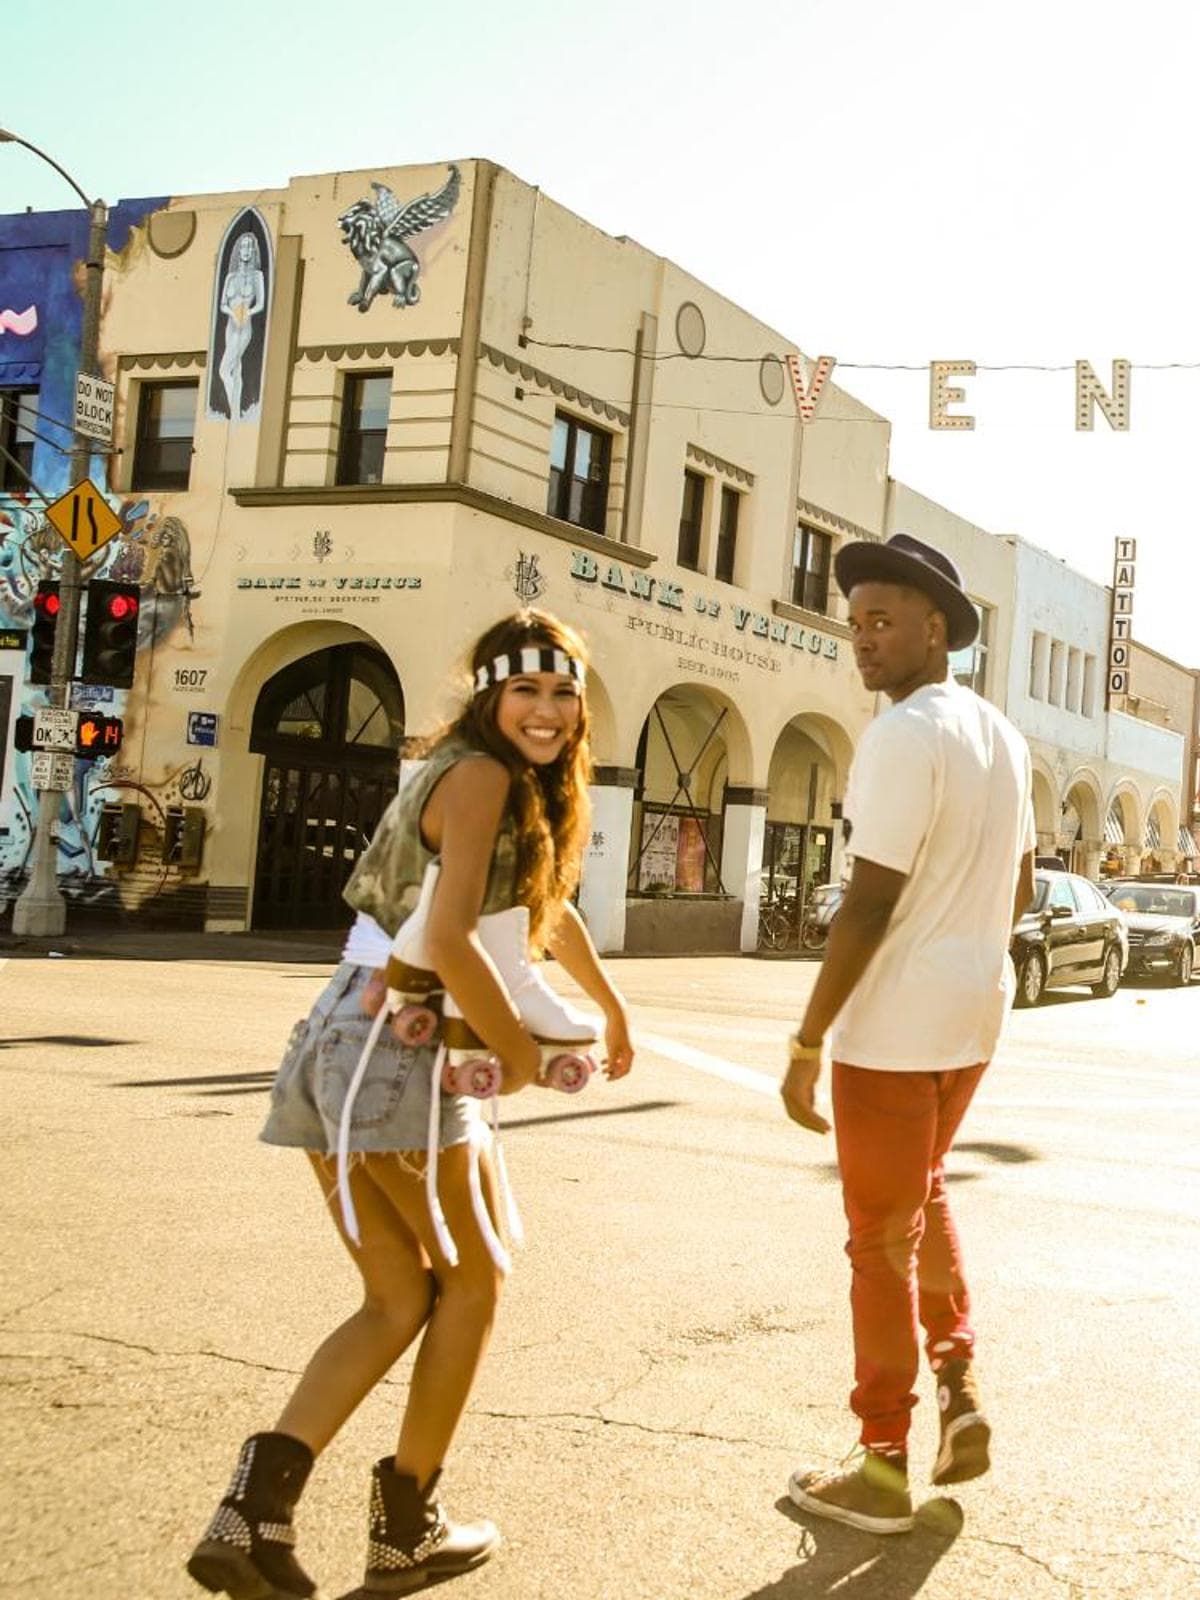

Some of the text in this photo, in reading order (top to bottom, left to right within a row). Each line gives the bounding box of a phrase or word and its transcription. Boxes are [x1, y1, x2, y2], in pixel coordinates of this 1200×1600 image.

[77, 380, 113, 404] DO NOT
[76, 400, 113, 423] BLOCK
[237, 576, 301, 590] BANK
[333, 576, 422, 590] VENICE
[570, 549, 684, 613] BANK
[730, 603, 839, 661] VENICE
[1111, 540, 1131, 690] TATTOO
[624, 615, 782, 673] PUBLIC HOUSE
[174, 669, 208, 686] 1607
[36, 727, 53, 742] OK
[104, 725, 118, 744] 14
